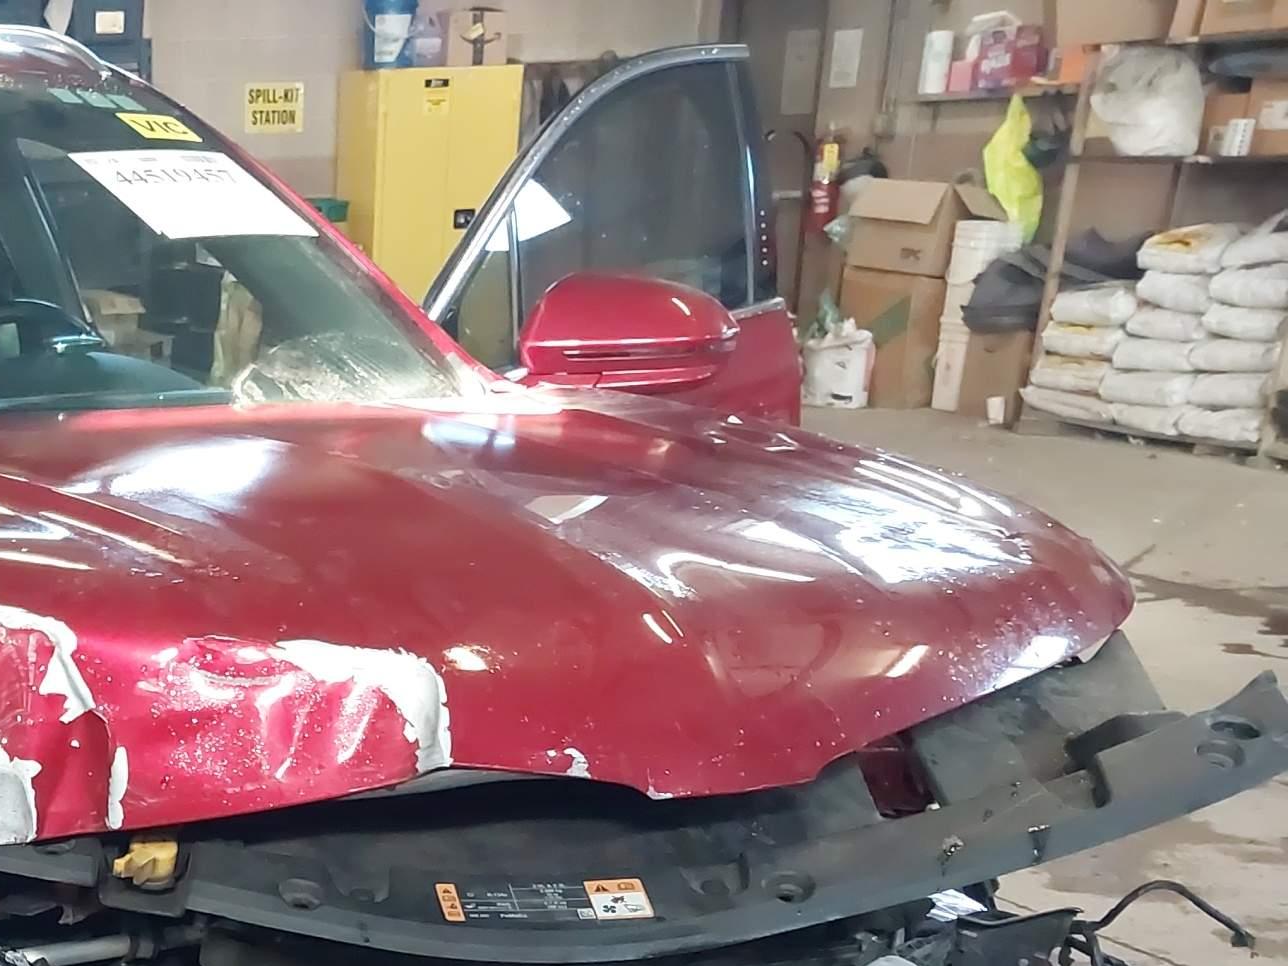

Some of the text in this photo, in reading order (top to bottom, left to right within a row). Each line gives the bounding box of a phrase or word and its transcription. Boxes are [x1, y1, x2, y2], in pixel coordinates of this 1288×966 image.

[248, 88, 300, 104] SPILL-KIT
[252, 110, 296, 125] STATION
[130, 119, 189, 135] VIC
[116, 168, 237, 185] 44519457
